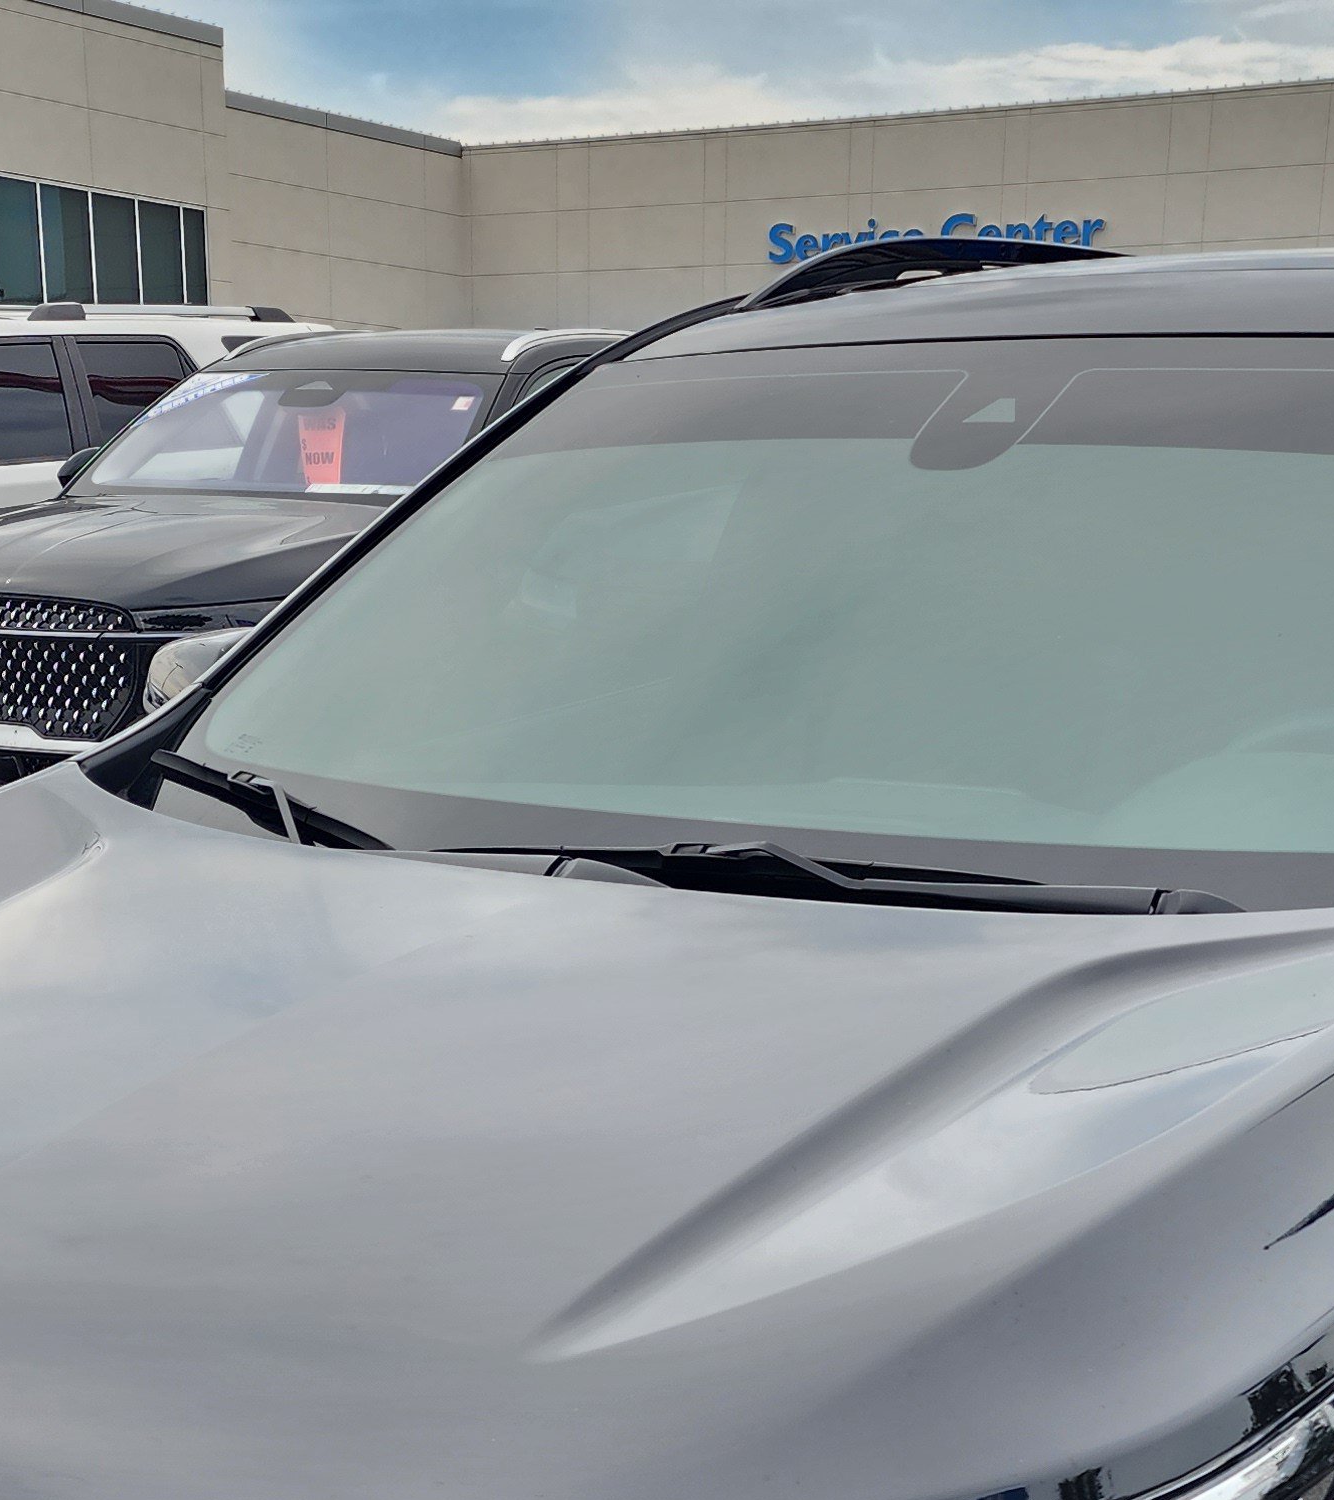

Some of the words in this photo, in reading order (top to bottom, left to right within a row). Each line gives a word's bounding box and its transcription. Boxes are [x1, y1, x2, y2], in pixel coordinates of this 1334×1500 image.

[768, 218, 923, 263] Seri
[303, 418, 337, 432] WAS
[305, 451, 335, 466] NOW
